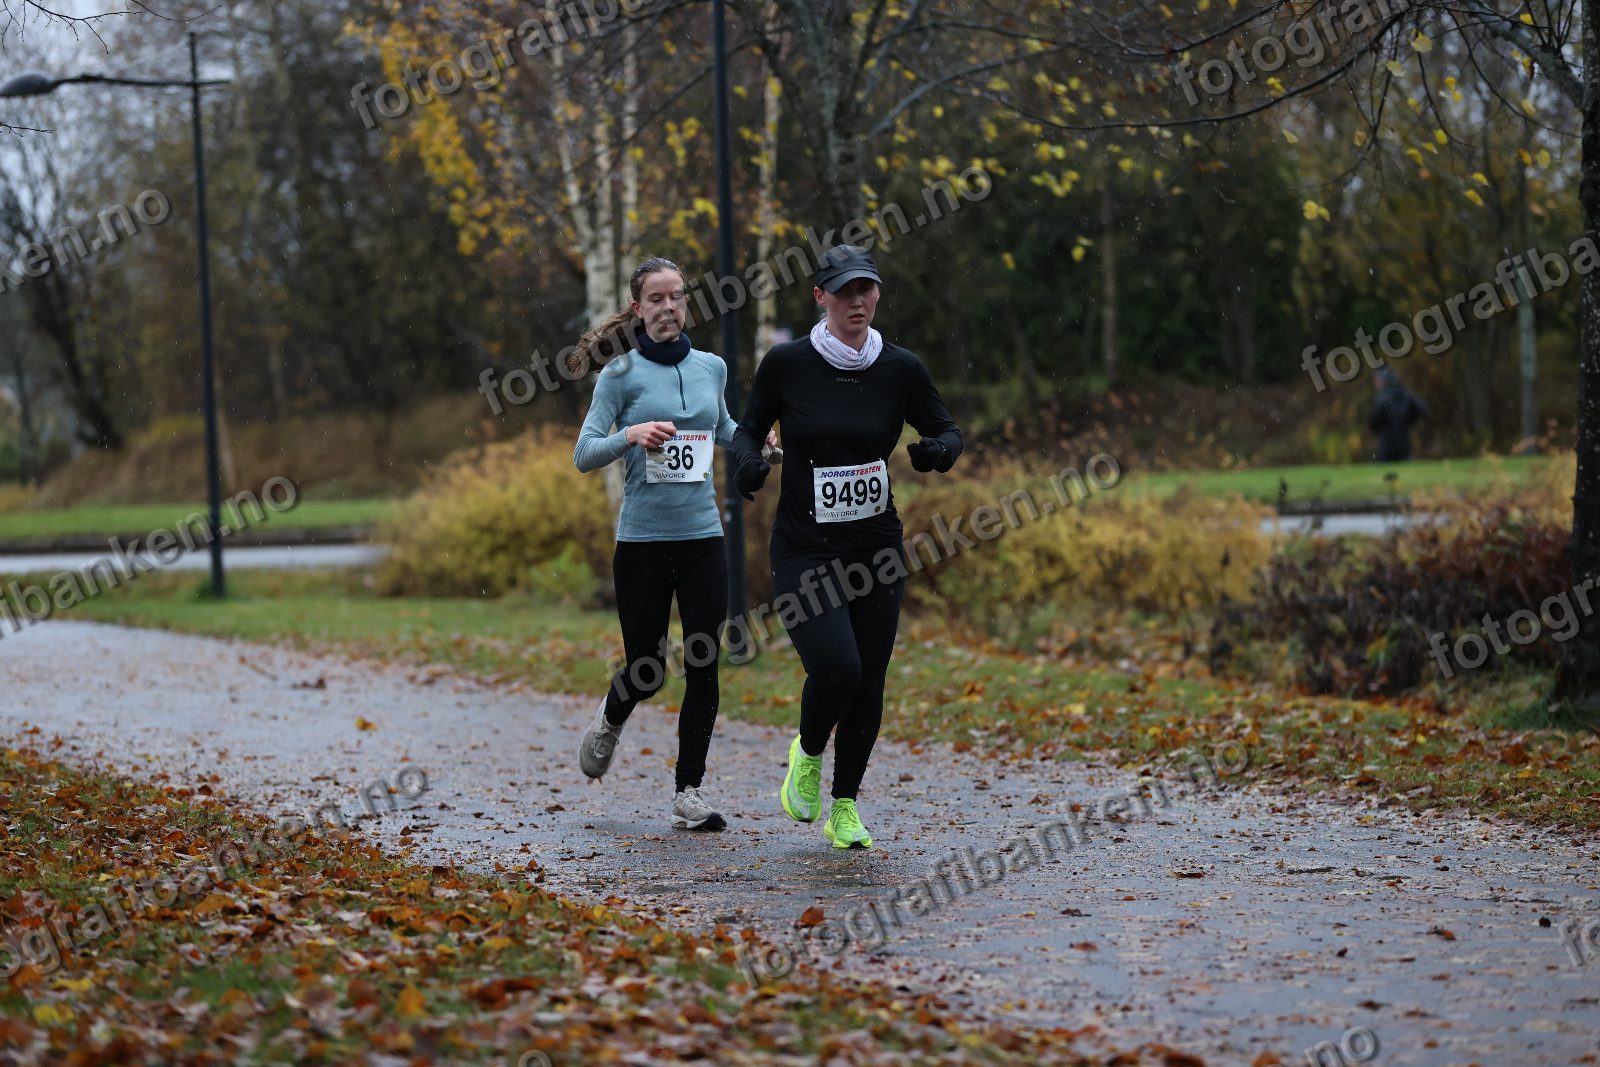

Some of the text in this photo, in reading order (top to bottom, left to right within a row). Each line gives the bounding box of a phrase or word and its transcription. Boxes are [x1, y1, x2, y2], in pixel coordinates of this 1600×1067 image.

[667, 445, 694, 471] 36
[820, 465, 882, 479] NORGESTESTEN
[821, 476, 882, 509] 9499
